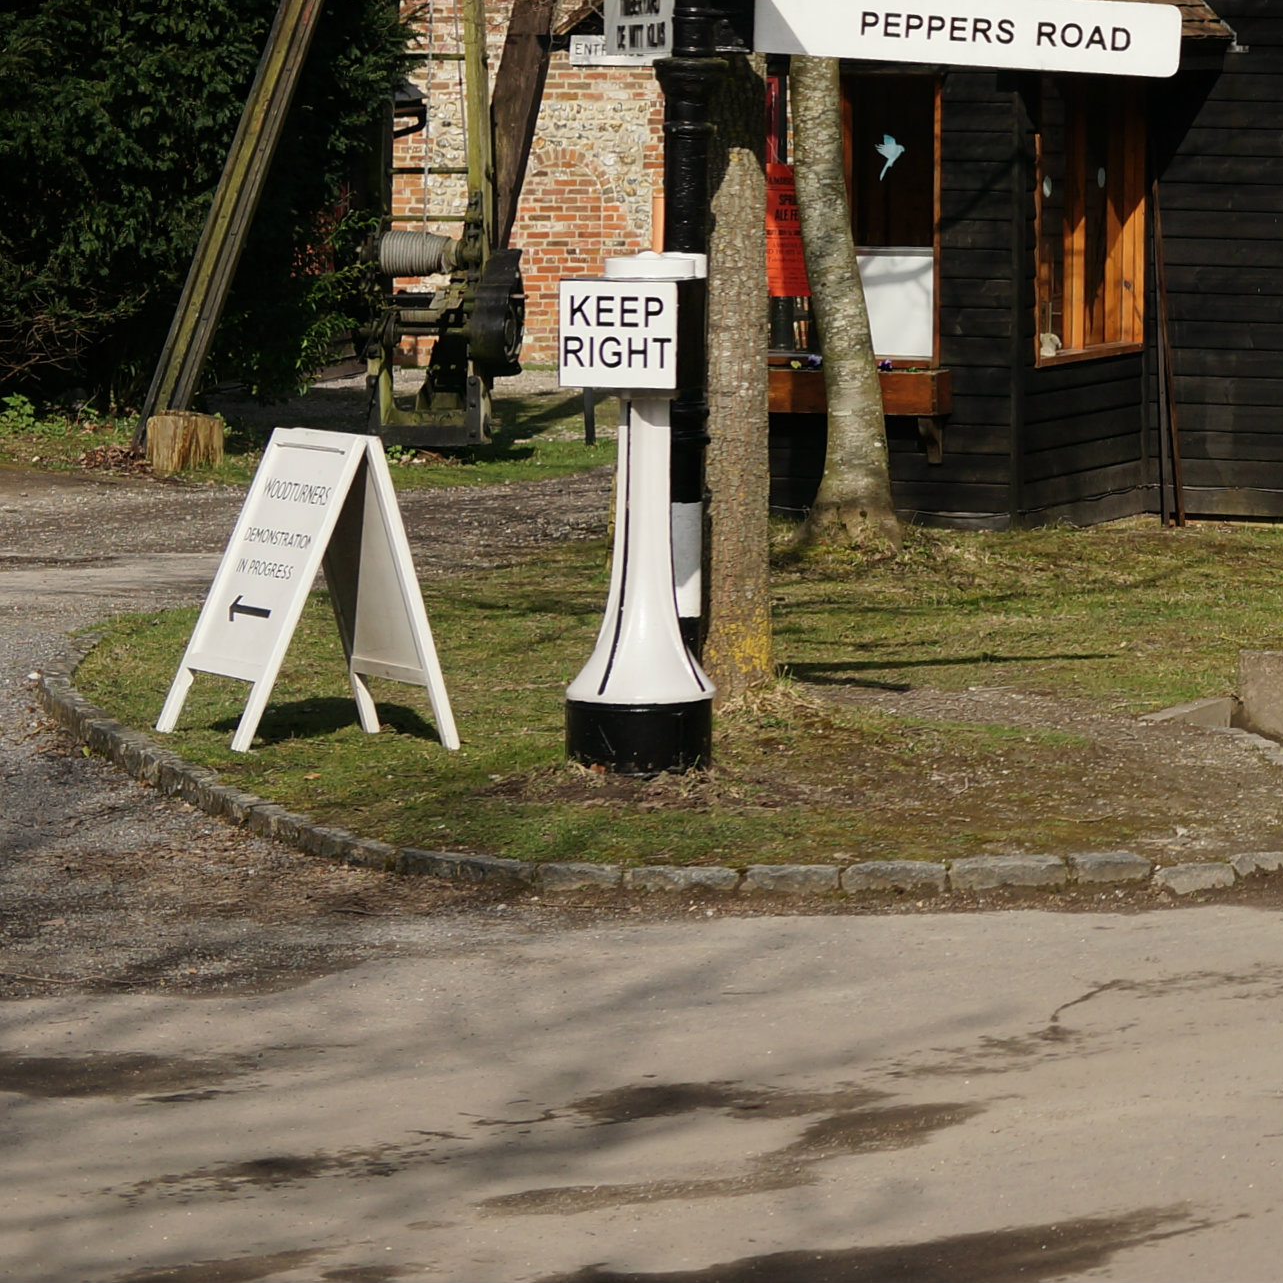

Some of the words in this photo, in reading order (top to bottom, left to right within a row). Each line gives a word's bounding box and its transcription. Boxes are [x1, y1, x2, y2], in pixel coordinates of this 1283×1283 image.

[859, 11, 1015, 44] PEPPERS
[1036, 21, 1132, 52] ROAD
[569, 295, 665, 328] KEEP
[562, 336, 673, 370] RIGHT
[263, 477, 332, 506] WOODTURNERS
[236, 558, 249, 574] IN
[248, 559, 294, 580] PROGRESS
